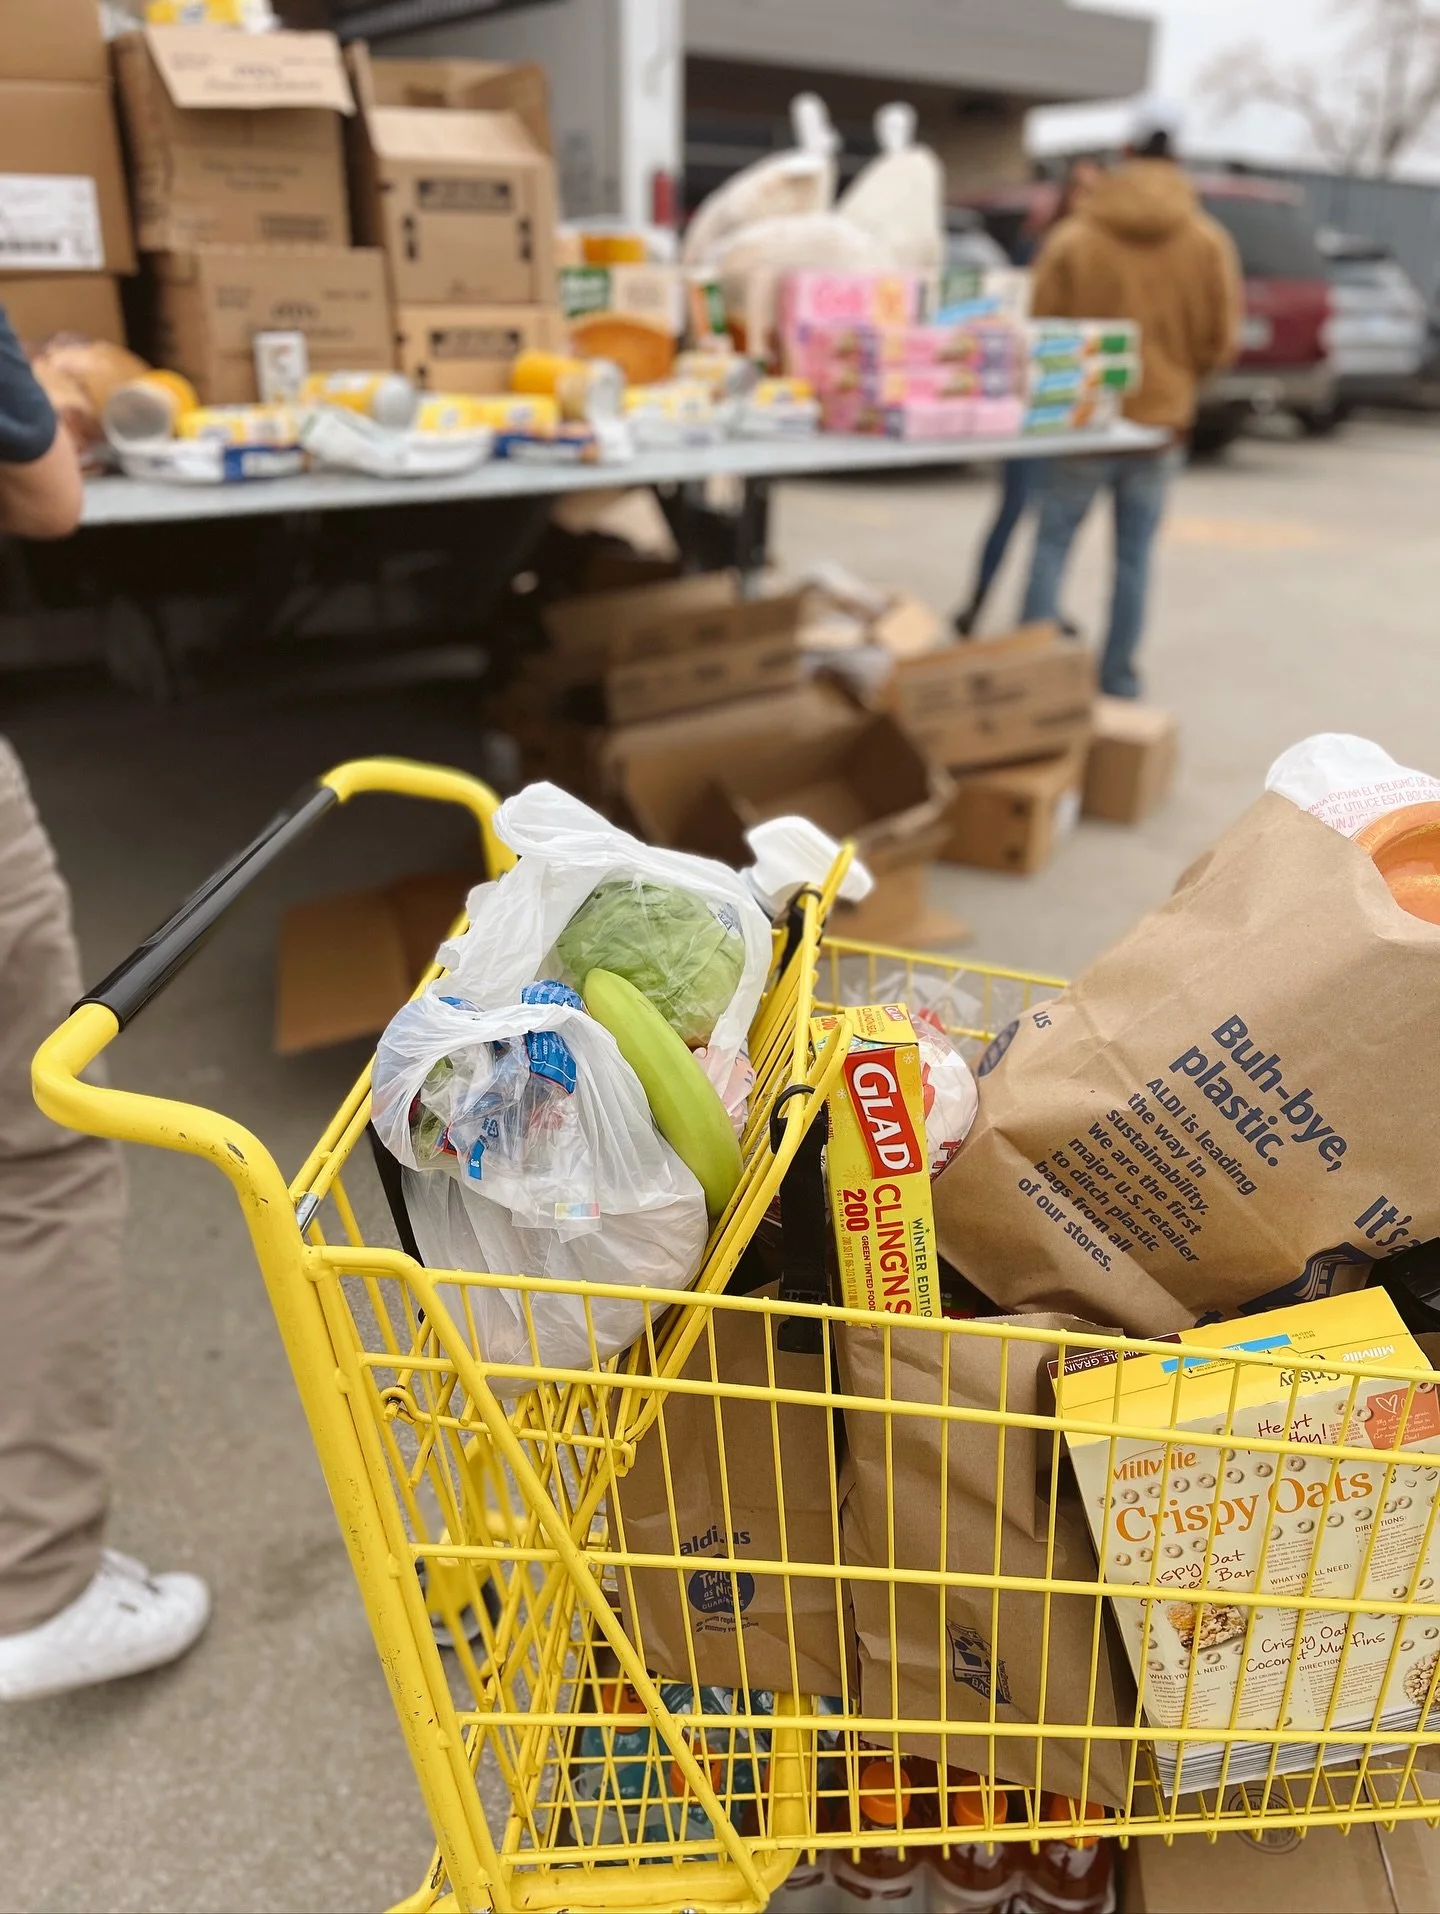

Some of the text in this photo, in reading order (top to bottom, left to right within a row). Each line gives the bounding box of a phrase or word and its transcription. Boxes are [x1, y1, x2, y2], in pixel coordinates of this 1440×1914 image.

[1343, 796, 1381, 812] UTILICE
[1382, 791, 1408, 806] ESTA
[1407, 789, 1435, 802] BOLSA
[1361, 786, 1373, 797] EL
[1415, 776, 1427, 787] DE
[1168, 1045, 1285, 1168] plastic.
[1210, 1014, 1347, 1173] Buh-bye,
[852, 1061, 915, 1171] GLAD
[1127, 1092, 1207, 1179] the way in
[1145, 1077, 1258, 1196] ALDI is leading
[1088, 1121, 1202, 1236] We are the first
[1106, 1109, 1210, 1216] sustainability.
[842, 1188, 870, 1232] 200
[1034, 1160, 1135, 1253] bags from all
[1051, 1150, 1161, 1252] to ditch plastic
[1068, 1137, 1200, 1263] major U.S. retailer
[1354, 1195, 1413, 1247] It's
[1018, 1177, 1112, 1273] of our stores.
[861, 1235, 871, 1261] GREEN
[912, 1217, 933, 1318] WINTER EDITIO
[864, 1261, 874, 1289] TINTED
[1064, 1357, 1101, 1373] GRAIN
[1343, 1344, 1395, 1362] Millville
[1257, 1414, 1312, 1437] Hert
[1113, 1451, 1197, 1482] Millvlle
[1116, 1471, 1373, 1543] Crispy Oats
[1355, 1515, 1408, 1533] DIRETIONS:
[680, 1525, 751, 1556] aldi.us
[1270, 1575, 1294, 1586] WHAT
[1327, 1563, 1352, 1574] NEED:
[1299, 1658, 1343, 1672] DIRECTION
[1313, 1630, 1386, 1658] Mufins
[1149, 1673, 1173, 1682] WHAT
